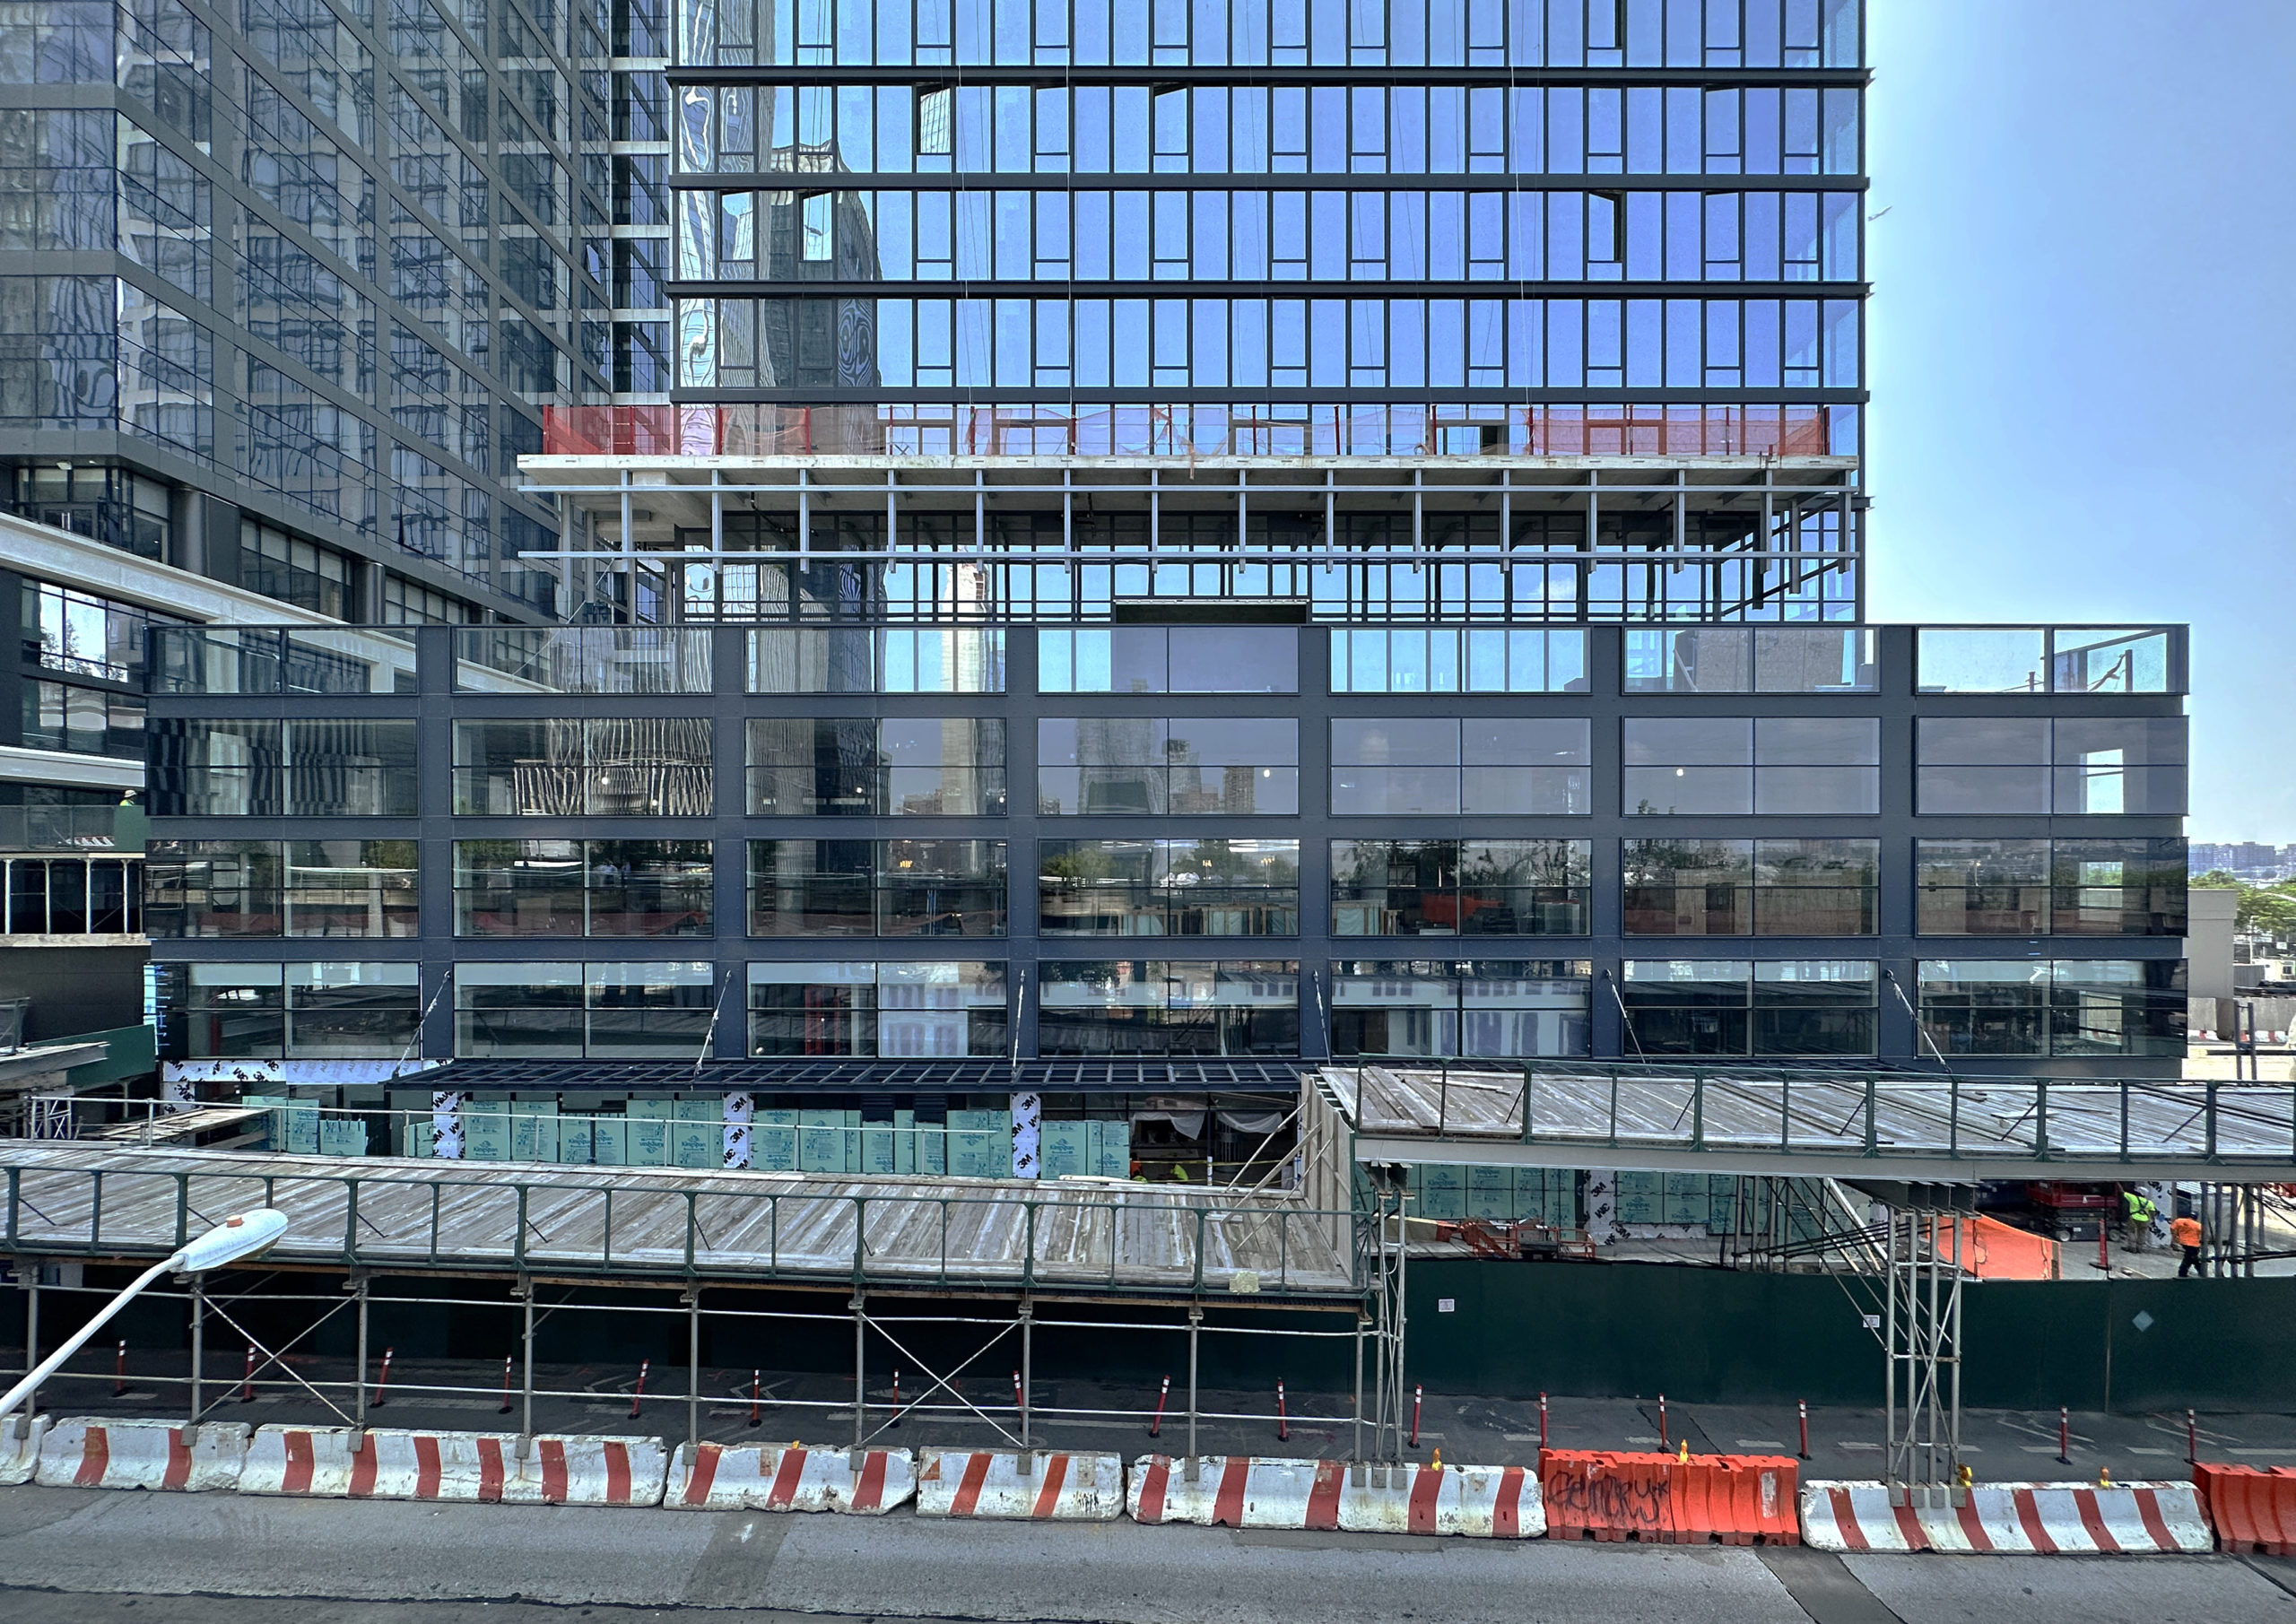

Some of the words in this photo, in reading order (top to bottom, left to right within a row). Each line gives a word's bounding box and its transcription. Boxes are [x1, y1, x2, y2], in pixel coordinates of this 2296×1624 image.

[732, 1097, 747, 1112] 3M
[1022, 1095, 1037, 1111] 3M
[730, 1128, 745, 1143] 3M
[1017, 1153, 1033, 1169] 3M
[1590, 1181, 1606, 1197] 3M
[1595, 1203, 1610, 1219] 3M
